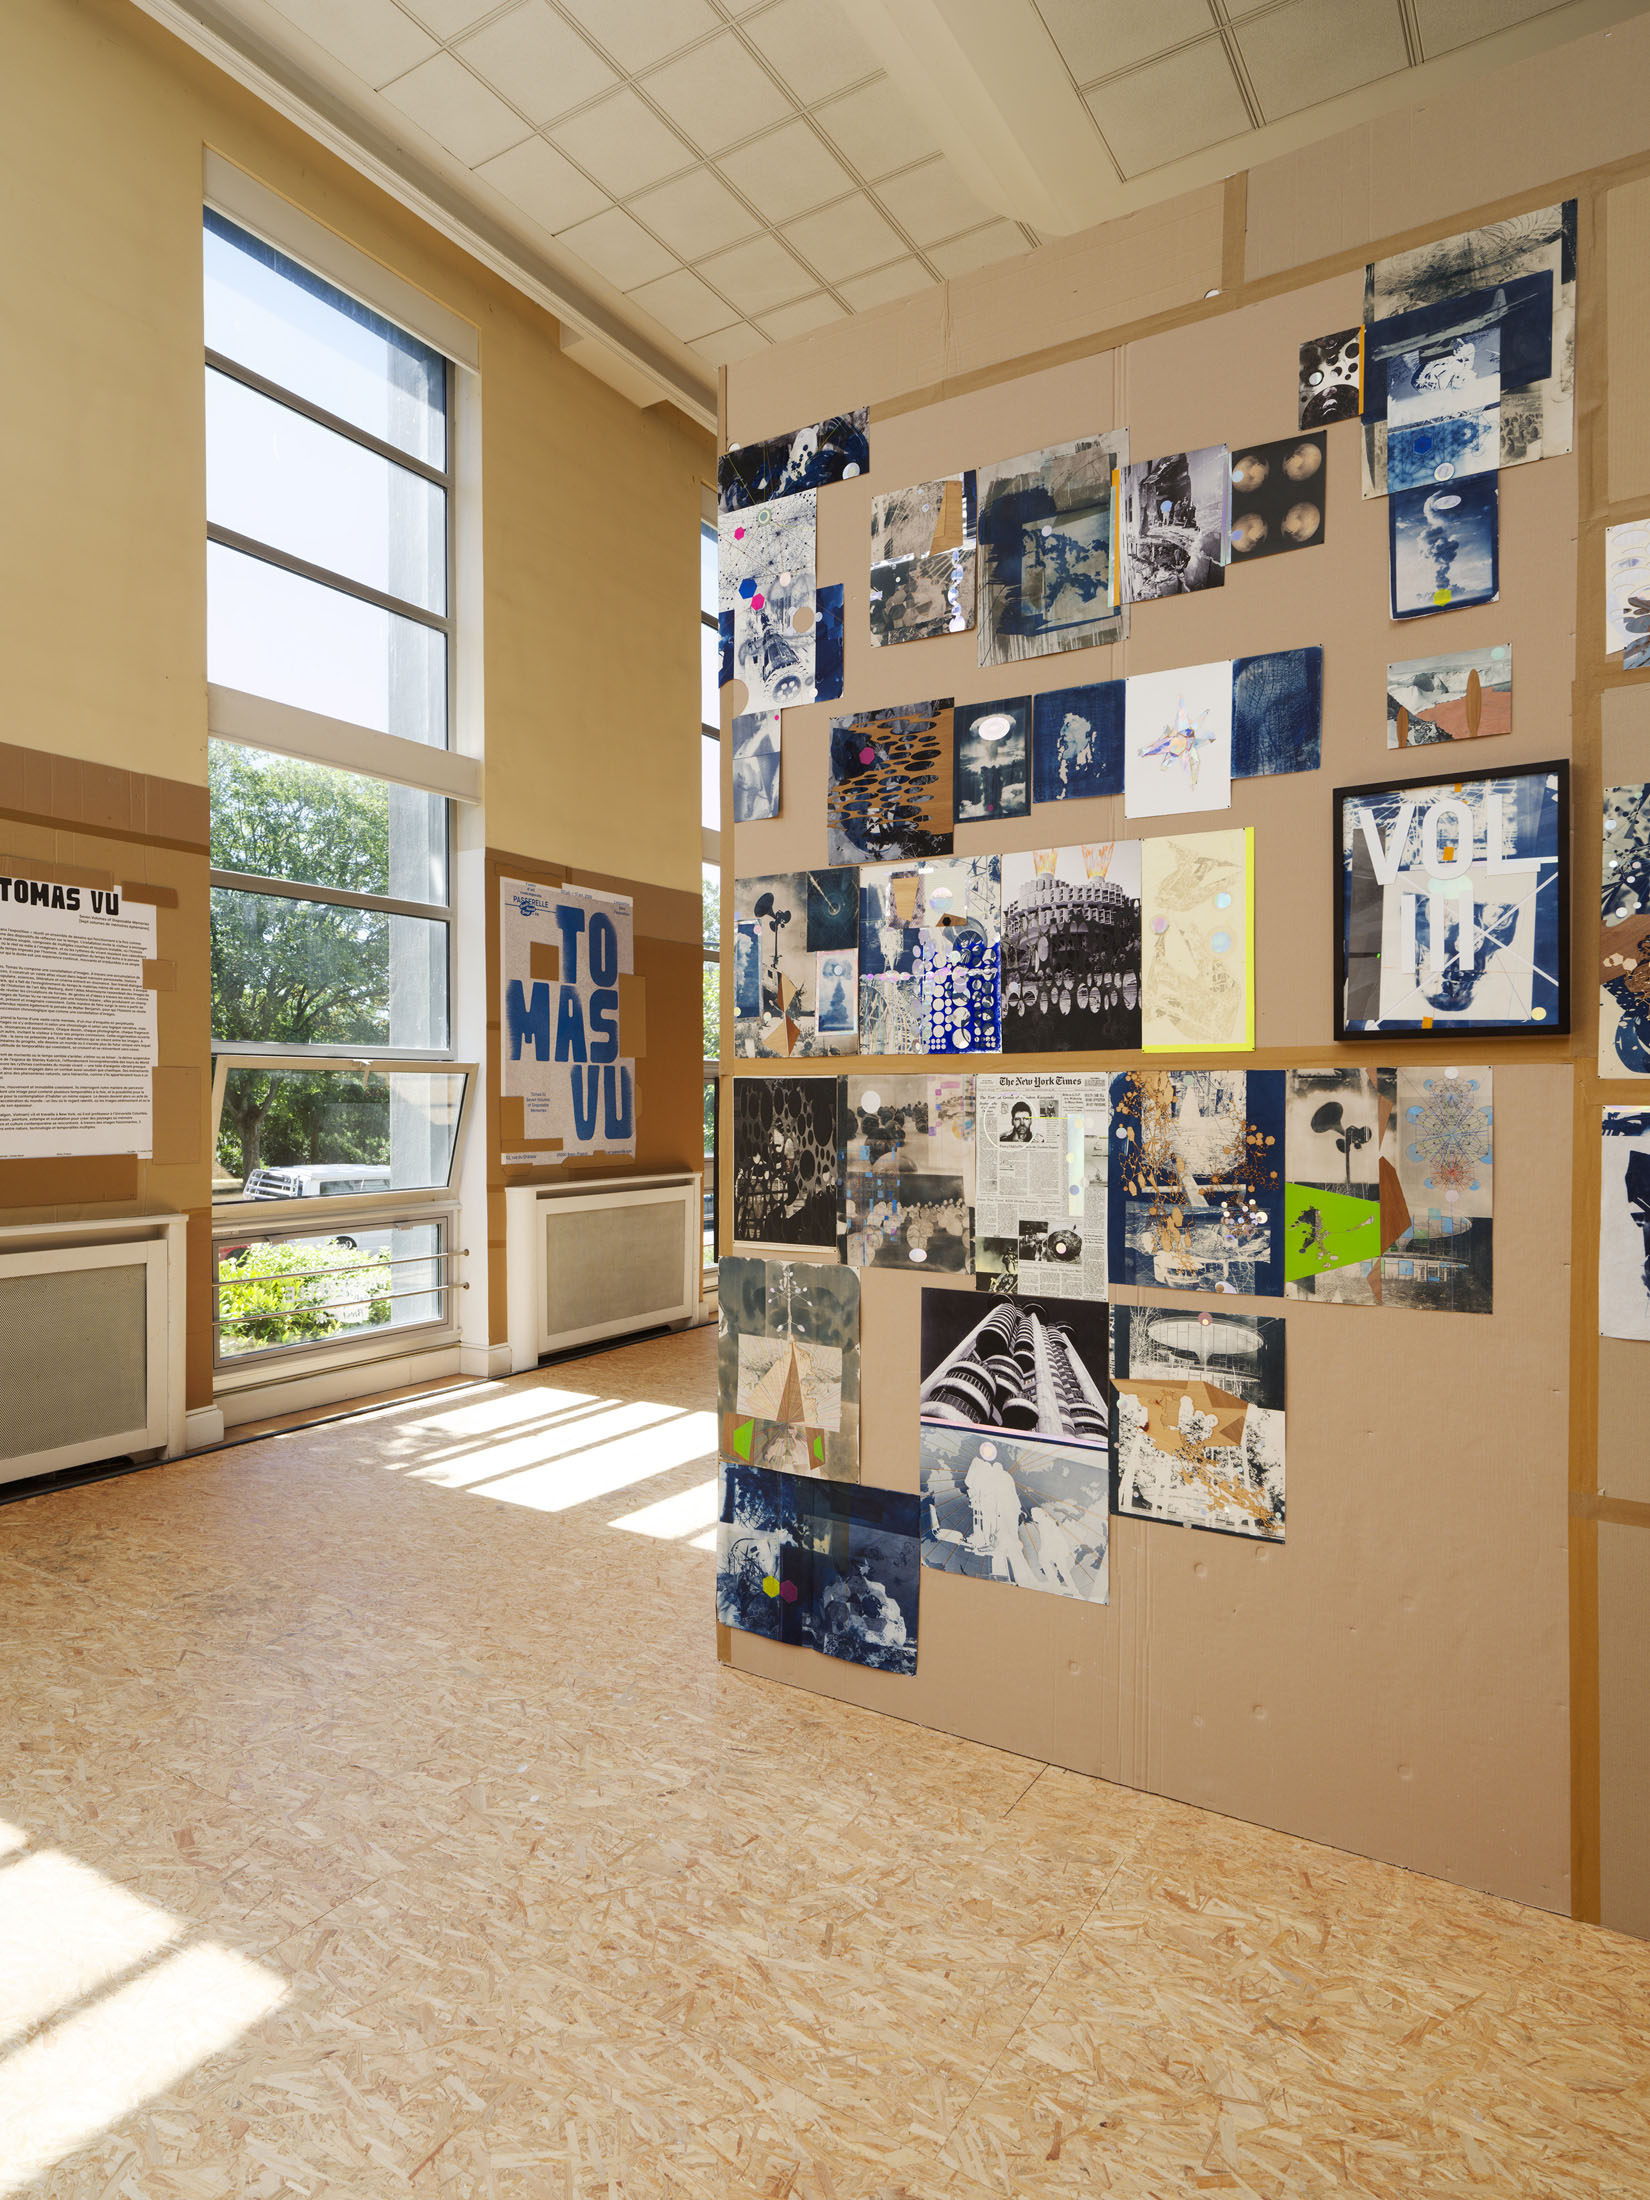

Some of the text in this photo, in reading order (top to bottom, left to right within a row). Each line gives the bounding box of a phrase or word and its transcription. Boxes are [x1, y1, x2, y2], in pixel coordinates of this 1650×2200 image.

[1358, 793, 1541, 885] VOL
[0, 877, 119, 916] TOMAS VU
[513, 896, 549, 908] PASSERELLE
[556, 904, 618, 987] TO
[506, 979, 619, 1063] MAS
[570, 1064, 633, 1140] VU
[1000, 1077, 1015, 1087] The
[1015, 1077, 1033, 1086] New
[1034, 1076, 1055, 1087] York
[1055, 1075, 1082, 1086] Times
